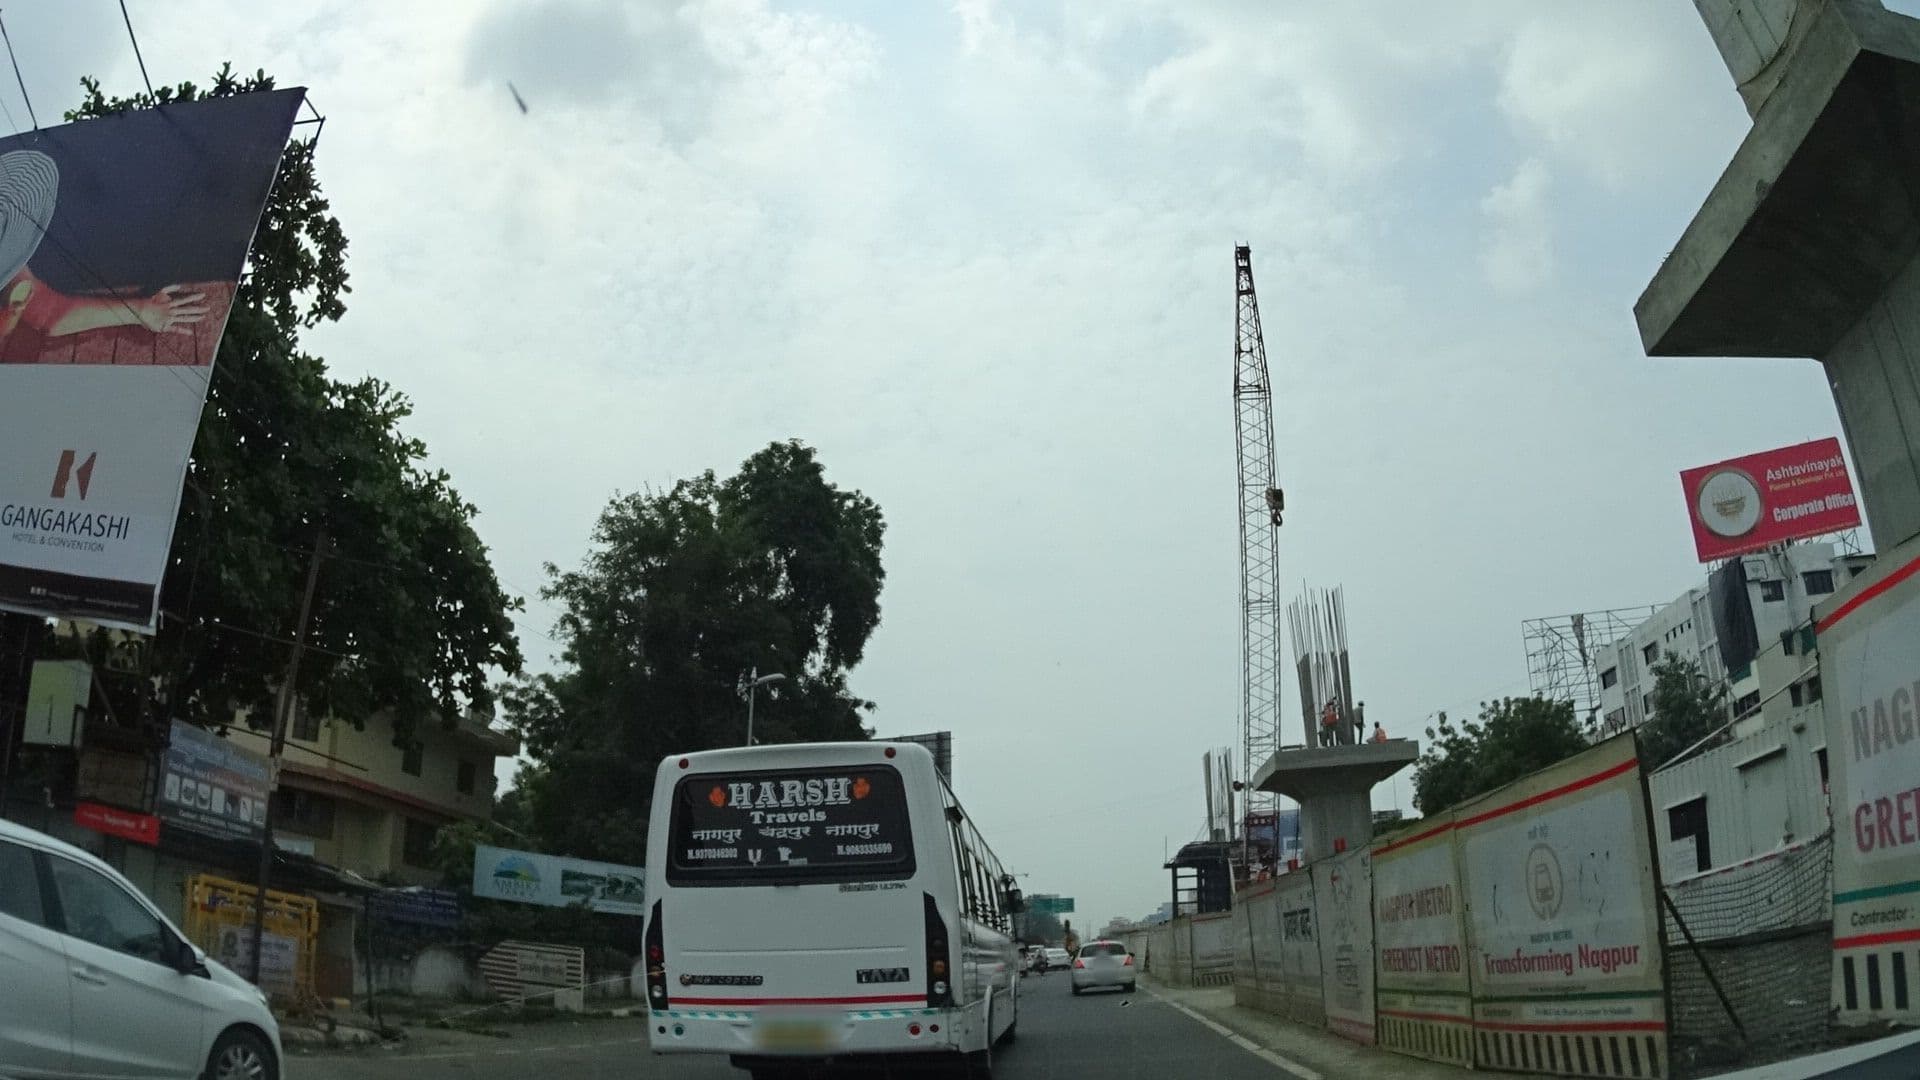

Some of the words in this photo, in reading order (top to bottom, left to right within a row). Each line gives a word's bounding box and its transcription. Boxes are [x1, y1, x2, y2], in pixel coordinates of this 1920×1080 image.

[1765, 454, 1844, 482] Ashtavinayak
[1773, 498, 1825, 523] Corporate
[1825, 492, 1856, 512] Office
[1, 504, 130, 540] GANGAKASHI
[47, 536, 105, 552] CONVENTION
[727, 777, 852, 809] HARSH
[750, 808, 827, 825] Travels
[692, 828, 742, 844] नागपुर
[825, 823, 880, 839] नागपुर
[1382, 947, 1422, 972] GREENEST
[1425, 944, 1460, 972] METRO
[1483, 947, 1574, 976] Transforming
[1577, 944, 1640, 974] Nagpur
[857, 967, 909, 984] TATA
